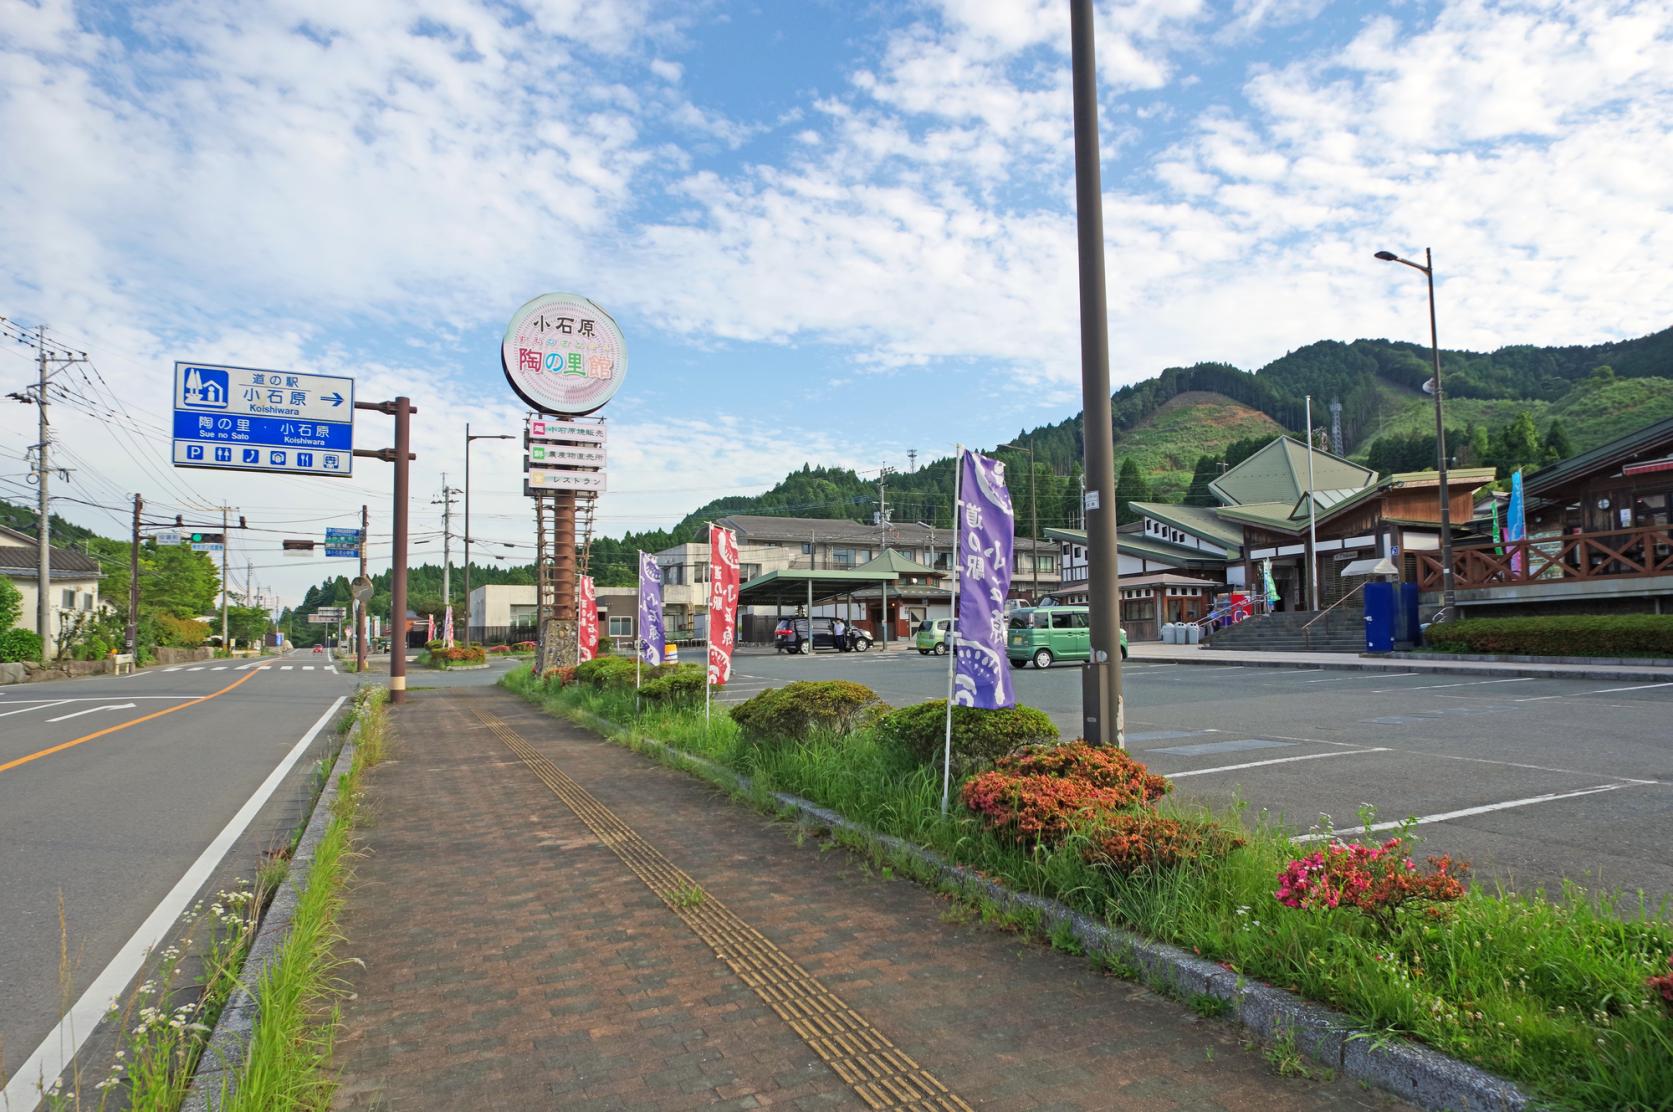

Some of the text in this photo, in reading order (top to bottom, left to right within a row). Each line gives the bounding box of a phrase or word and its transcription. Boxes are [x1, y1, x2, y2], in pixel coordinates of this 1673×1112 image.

[533, 315, 596, 338] 小石原
[518, 347, 613, 379] 陶の里館
[252, 373, 299, 388] 道の駅
[243, 388, 307, 406] 小石原
[249, 404, 300, 416] Koishiwara
[198, 415, 331, 438] 陶の里 小石原
[199, 429, 215, 438] Sue
[231, 431, 250, 441] Sato
[283, 436, 326, 446] Koishiwara
[553, 476, 601, 486] レストラン
